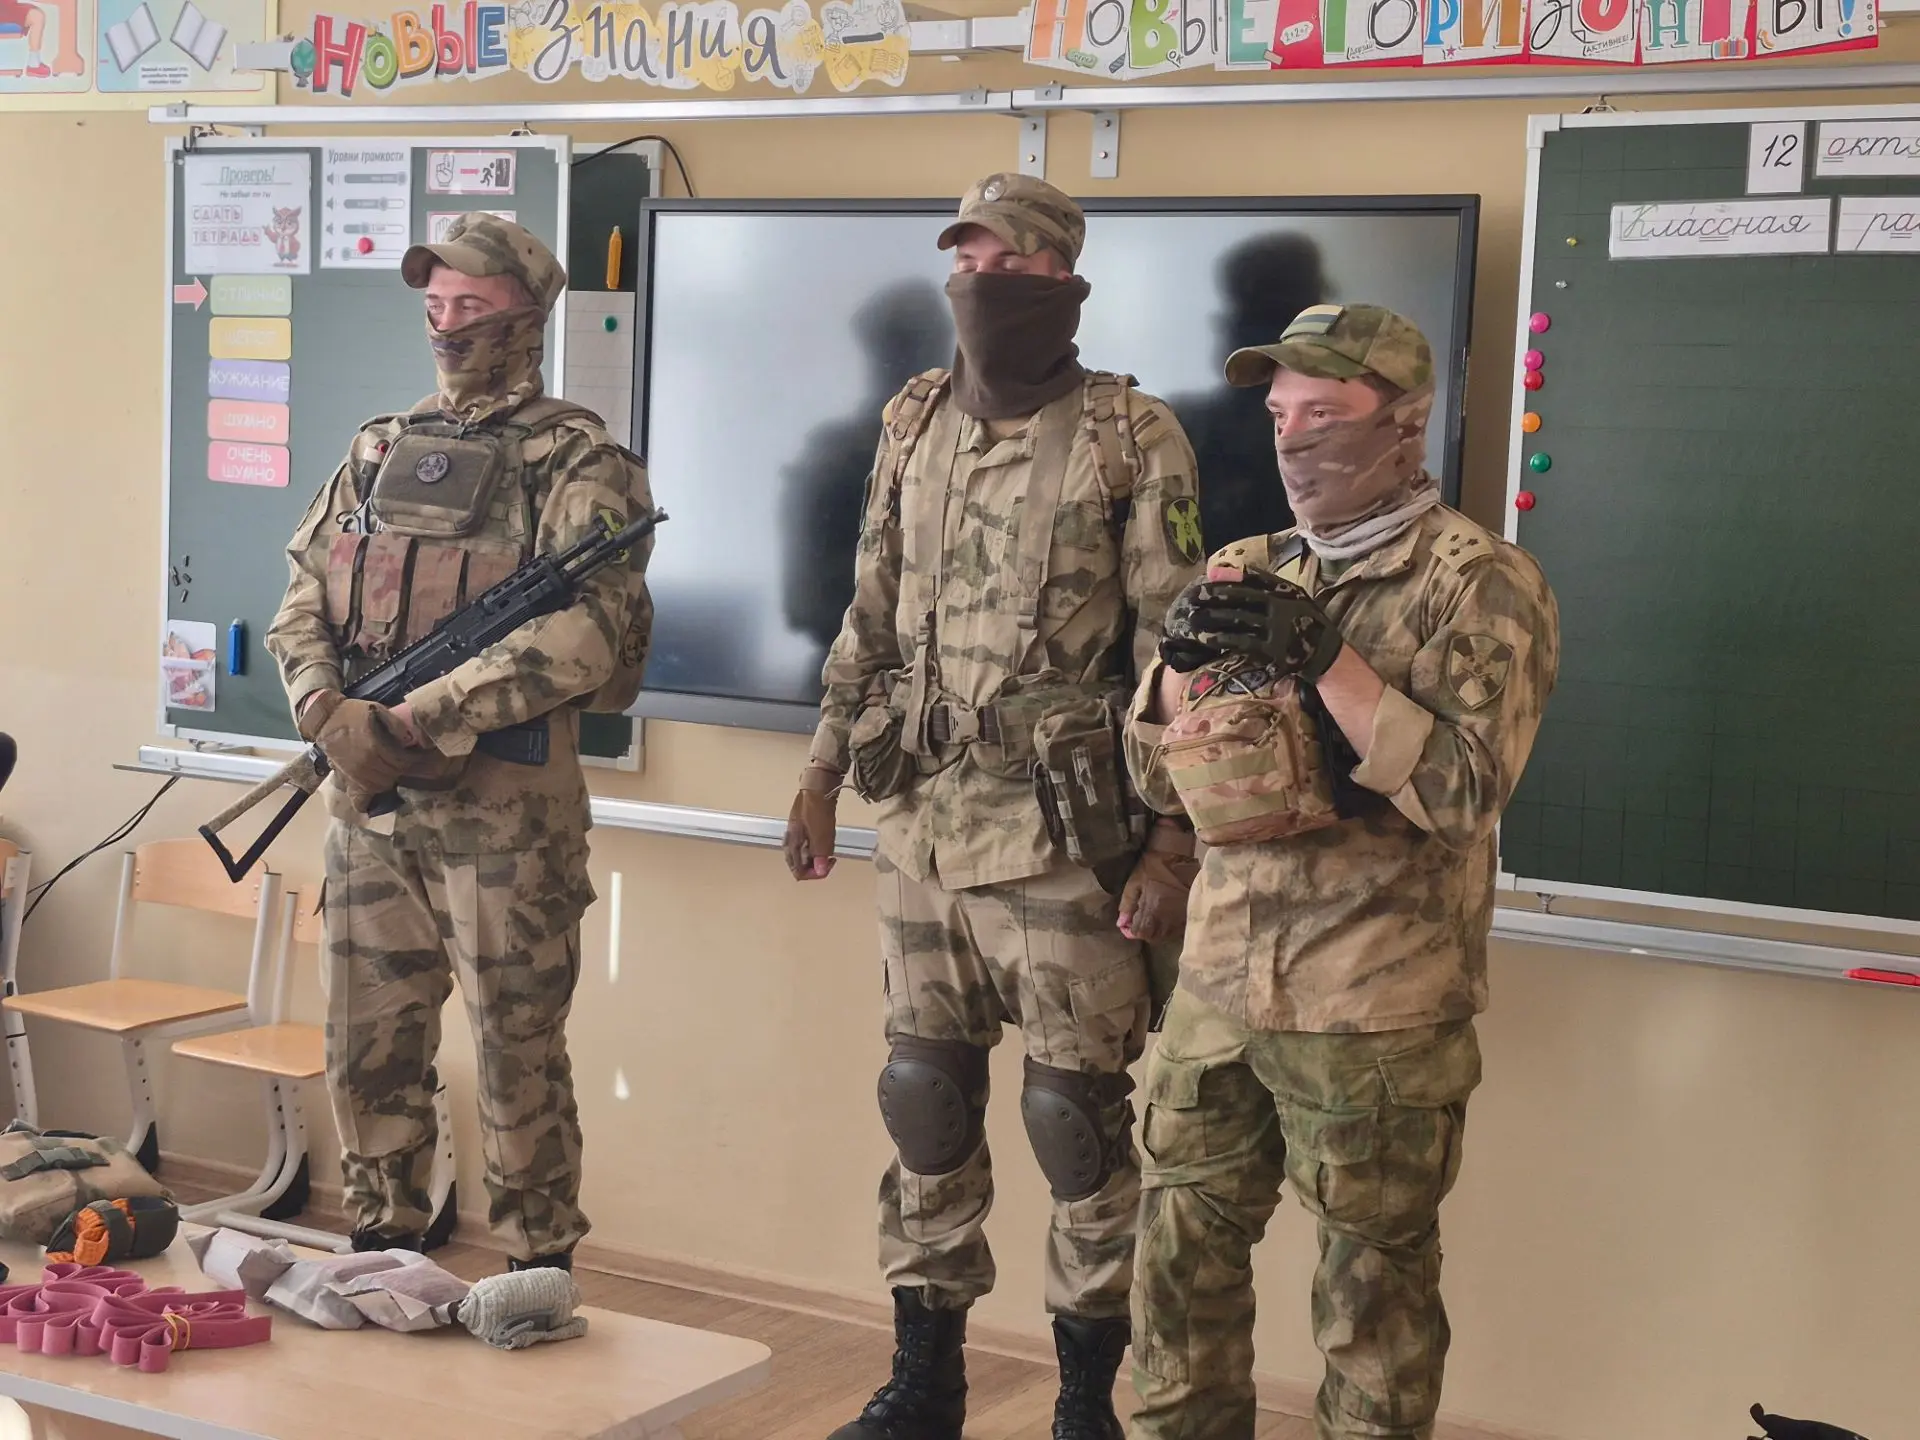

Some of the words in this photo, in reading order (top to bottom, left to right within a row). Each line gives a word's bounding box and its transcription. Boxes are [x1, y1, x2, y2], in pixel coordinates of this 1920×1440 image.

[534, 0, 787, 81] Знания
[328, 149, 359, 165] Уровни
[361, 151, 404, 164] громкости
[1763, 134, 1798, 168] 12
[220, 165, 276, 186] Проверь!
[193, 208, 241, 220] СДАТЬ
[193, 230, 260, 242] ТЕТРАДЬ
[1624, 203, 1811, 238] Классная
[1855, 212, 1920, 251] ра
[208, 368, 290, 392] ЖУЖЖАНИЕ
[223, 412, 277, 430] ШУМНО
[227, 446, 272, 464] ОЧЕНЬ
[222, 463, 276, 482] ШУМНО
